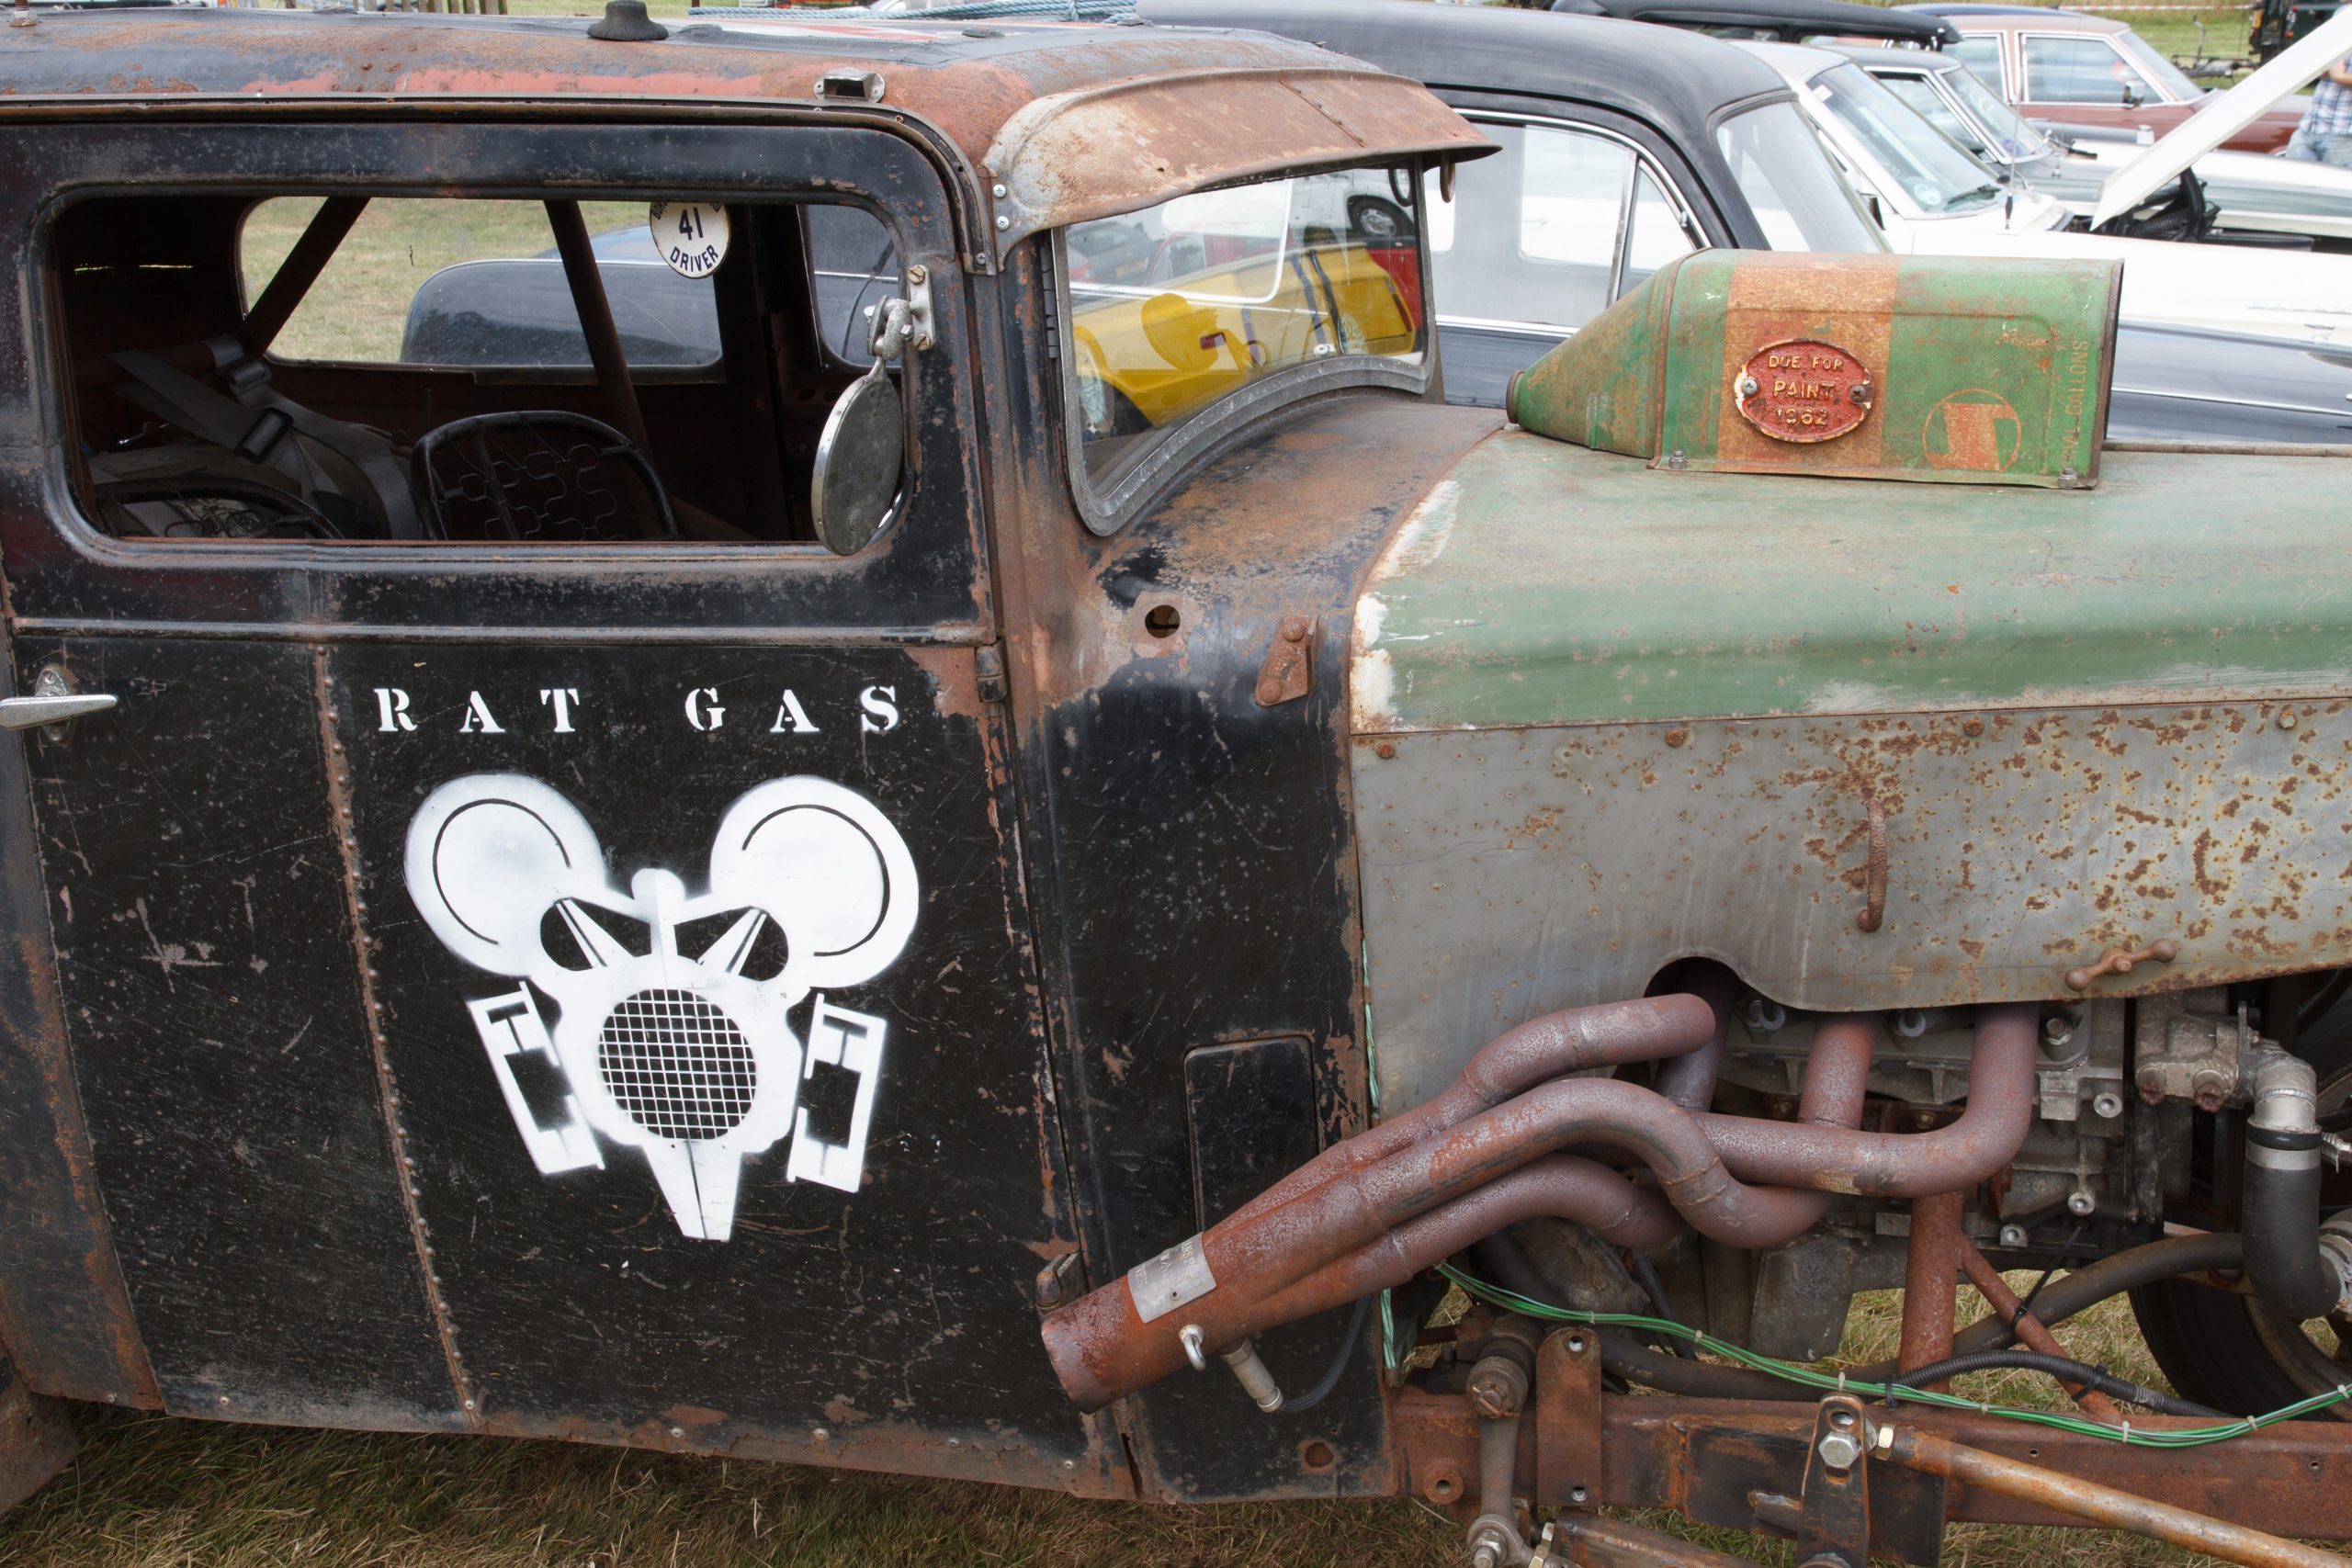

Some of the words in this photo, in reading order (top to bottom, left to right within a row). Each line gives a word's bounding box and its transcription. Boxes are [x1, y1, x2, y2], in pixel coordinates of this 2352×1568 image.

[679, 207, 704, 241] 41
[670, 244, 719, 272] DRIVER
[1768, 355, 1801, 368] DUE
[1812, 356, 1844, 370] FOR
[1773, 380, 1836, 400] PAINT
[2064, 340, 2090, 416] GALLONS
[1775, 408, 1830, 425] 1962
[373, 687, 580, 734] RAT
[684, 685, 900, 734] GAS
